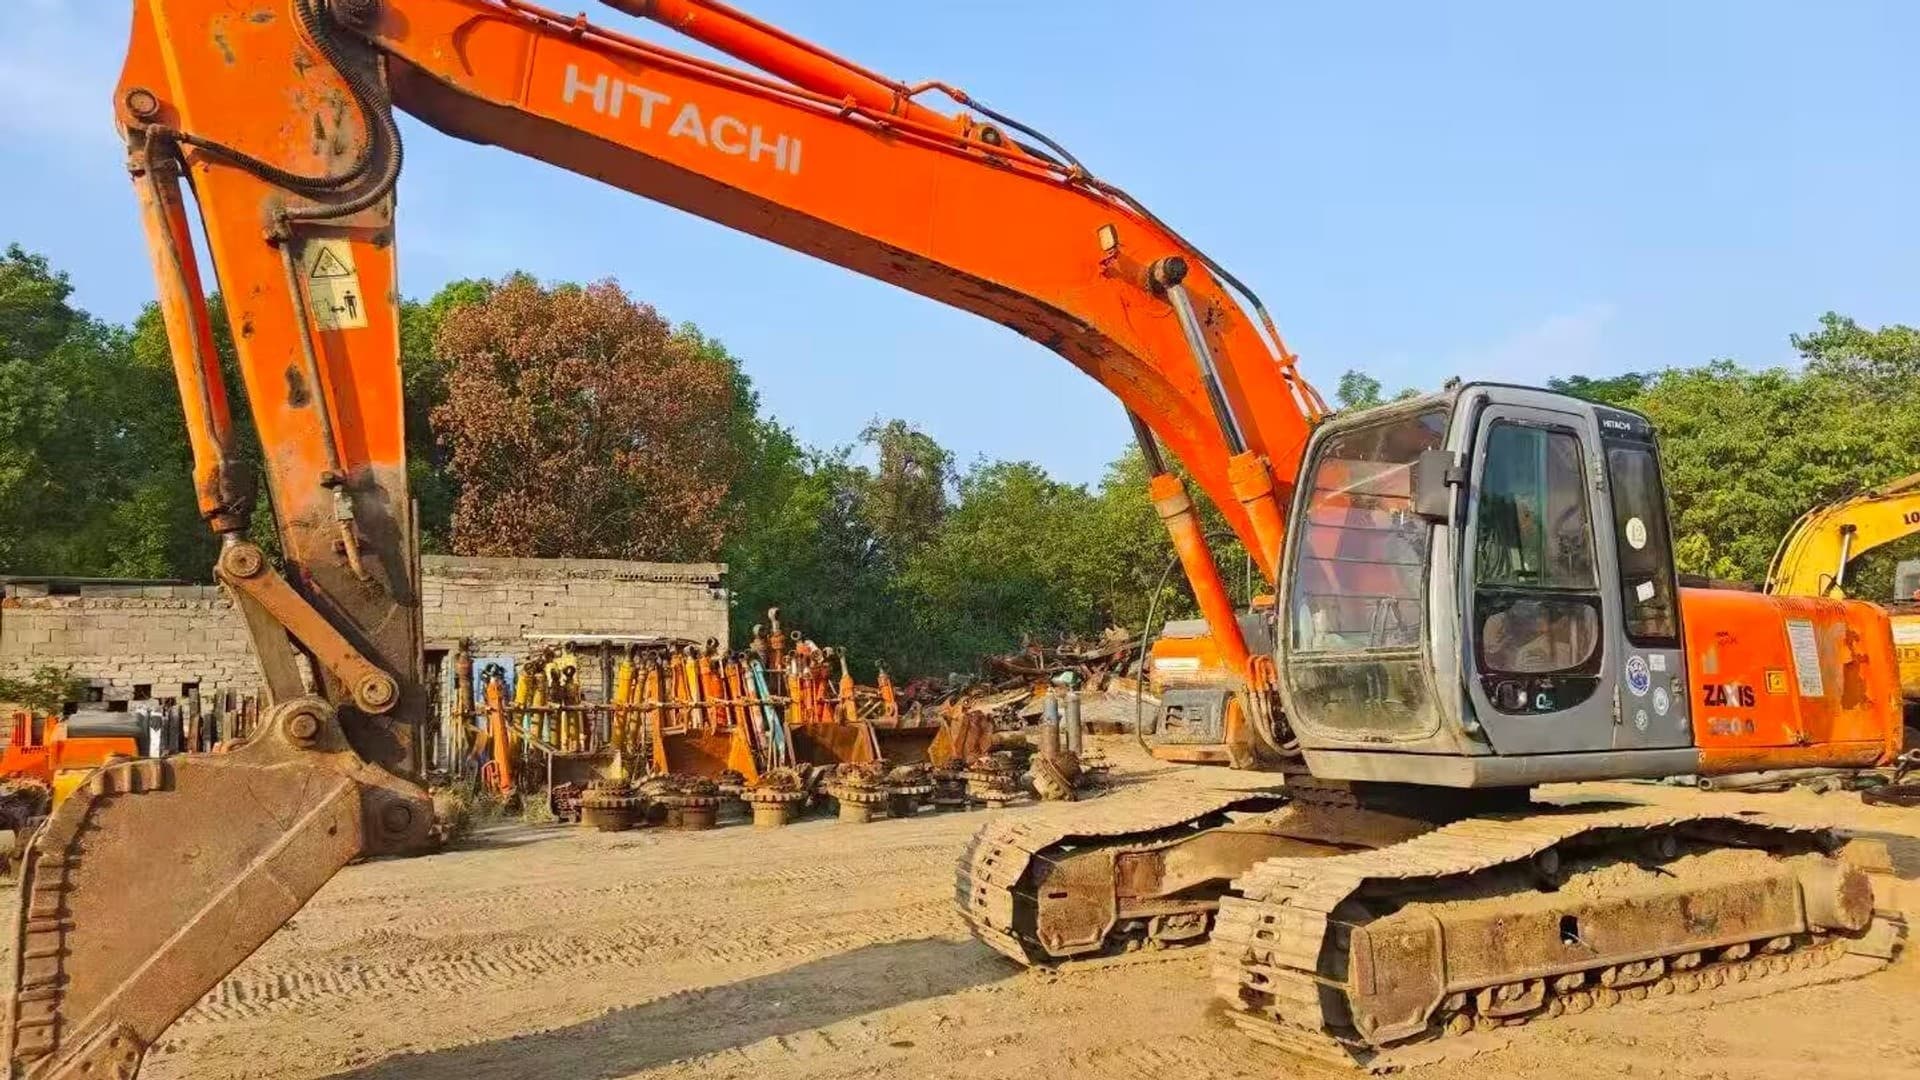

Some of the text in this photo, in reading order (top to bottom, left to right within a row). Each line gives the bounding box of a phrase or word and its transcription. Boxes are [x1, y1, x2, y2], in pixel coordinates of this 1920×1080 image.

[563, 64, 801, 174] HITACHI
[1602, 419, 1631, 431] HITACHI
[1703, 684, 1755, 707] ZAXIS
